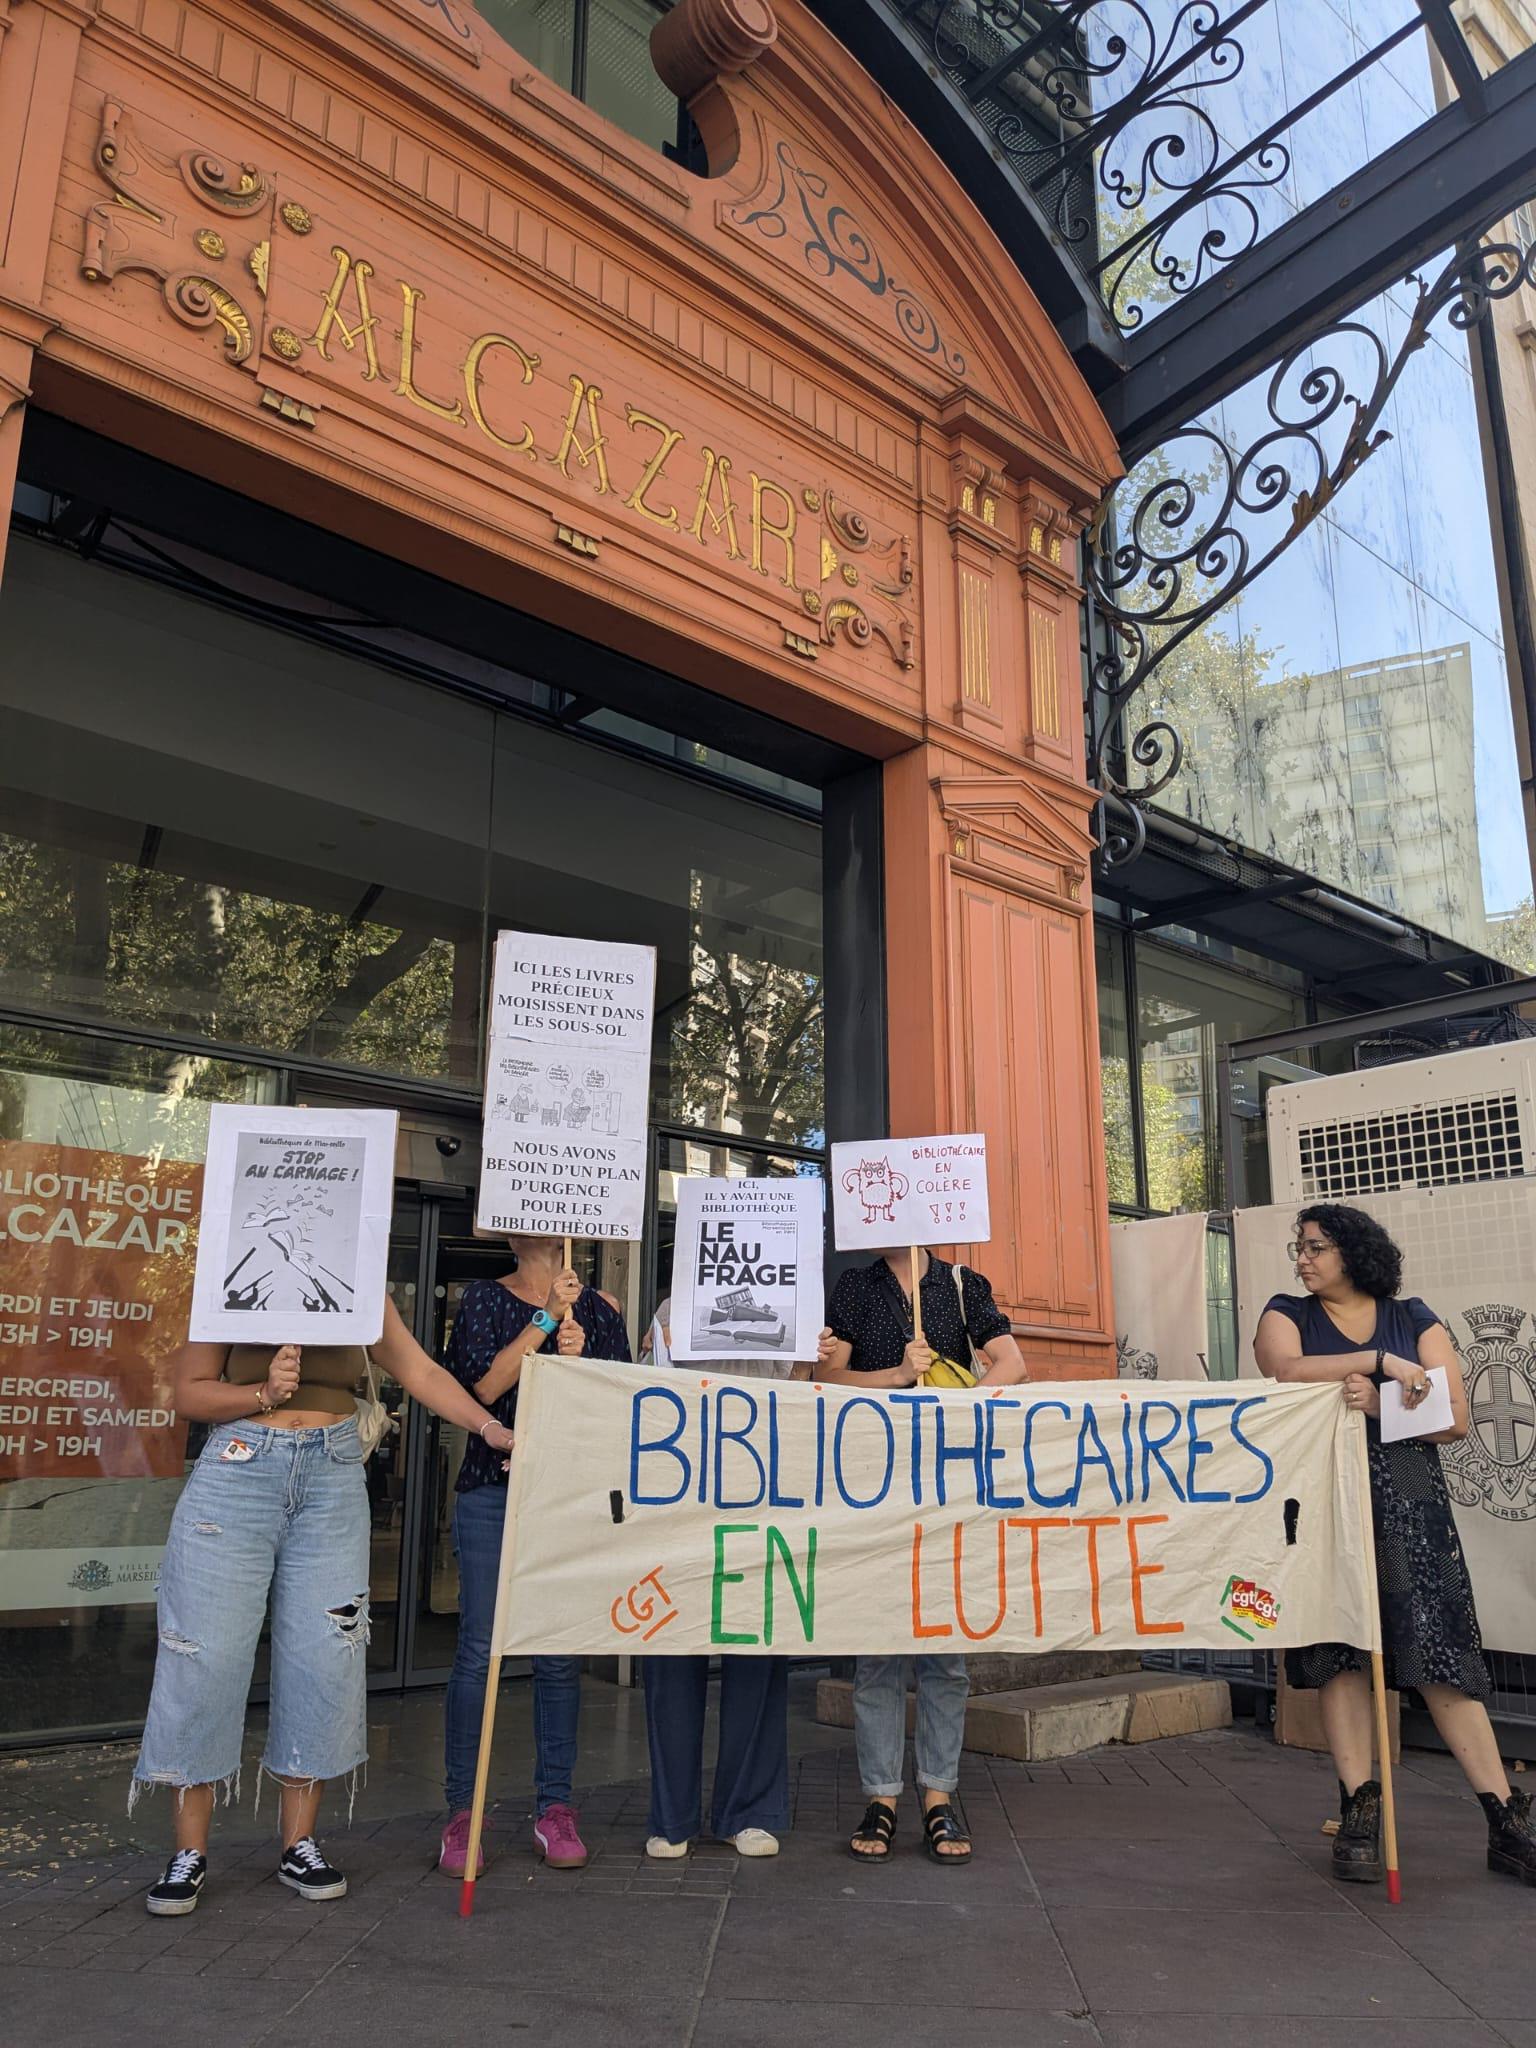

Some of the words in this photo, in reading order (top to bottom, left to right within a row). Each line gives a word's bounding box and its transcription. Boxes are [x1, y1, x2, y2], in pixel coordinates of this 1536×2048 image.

[299, 245, 801, 592] ALCAZAR
[513, 961, 537, 975] ICI
[541, 965, 572, 978] LES
[576, 968, 635, 985] LIVRES
[531, 981, 615, 1001] PRÉCIEUX
[498, 994, 598, 1017] MOISISSENT
[602, 1006, 646, 1021] DANS
[513, 1014, 544, 1028] LES
[548, 1018, 628, 1037] SOUS-SOL
[282, 1150, 325, 1165] STOP
[513, 1141, 559, 1157] NOUS
[562, 1146, 616, 1161] AVONS
[244, 1164, 269, 1178] AU
[273, 1165, 348, 1181] CARNAGE
[486, 1157, 548, 1175] BESOIN
[597, 1167, 641, 1181] PLAN
[935, 1162, 952, 1173] EN
[738, 1181, 759, 1189] ICI,
[916, 1177, 972, 1194] COLÈRE
[704, 1193, 717, 1201] IL
[720, 1193, 729, 1201] Y
[730, 1193, 766, 1201] AVAIT
[769, 1193, 795, 1201] UNE
[520, 1199, 567, 1214] POUR
[572, 1202, 602, 1217] LES
[701, 1202, 797, 1214] BIBLIOTHÈQUE
[0, 1204, 188, 1256] CAZAR
[491, 1215, 629, 1237] BIBLIOTHÈQUES
[701, 1222, 734, 1242] LE
[699, 1243, 761, 1263] NAU
[698, 1264, 797, 1286] FRAGE
[49, 1297, 81, 1317] ET
[85, 1300, 153, 1322] JEUDI
[69, 1327, 113, 1349] 19H
[46, 1406, 78, 1426] ET
[82, 1408, 176, 1428] SAMEDI
[56, 1436, 101, 1457] 19H
[1442, 1461, 1488, 1488] IMMENSIS
[1492, 1504, 1529, 1519] URBS
[610, 1565, 673, 1635] CGT
[710, 1524, 818, 1647] EN
[911, 1514, 1185, 1641] LUTTE
[1232, 1590, 1256, 1607] cgt
